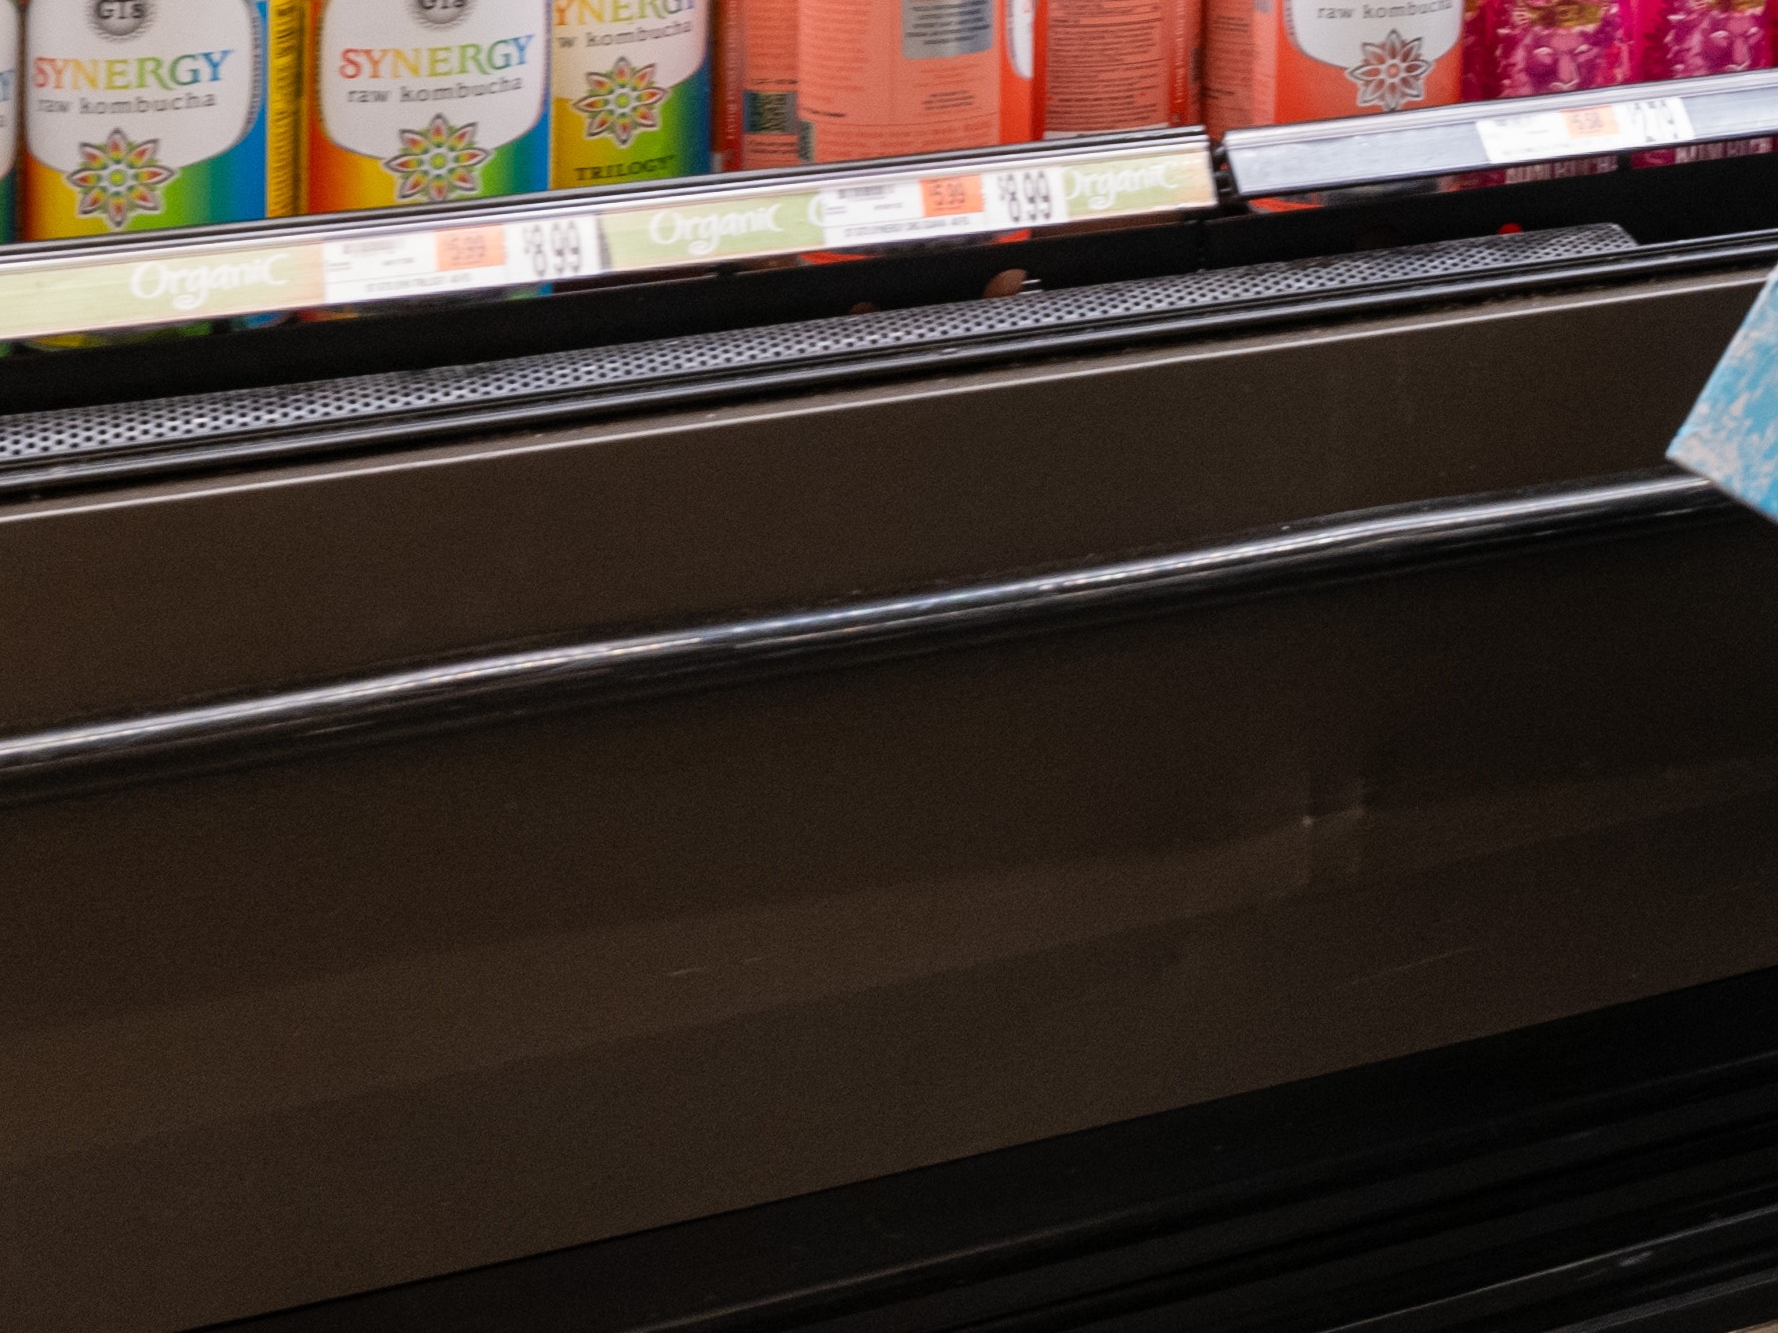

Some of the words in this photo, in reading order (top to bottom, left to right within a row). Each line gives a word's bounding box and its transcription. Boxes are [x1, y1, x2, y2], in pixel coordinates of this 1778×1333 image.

[1316, 4, 1354, 20] raw
[589, 18, 693, 49] kombucha
[34, 50, 234, 90] SYNERGY
[340, 34, 535, 80] SYNERGY
[34, 95, 72, 114] raw
[79, 90, 216, 117] kombucha
[348, 85, 387, 104] raw
[399, 73, 524, 102] kombucha
[650, 206, 782, 257] Organic
